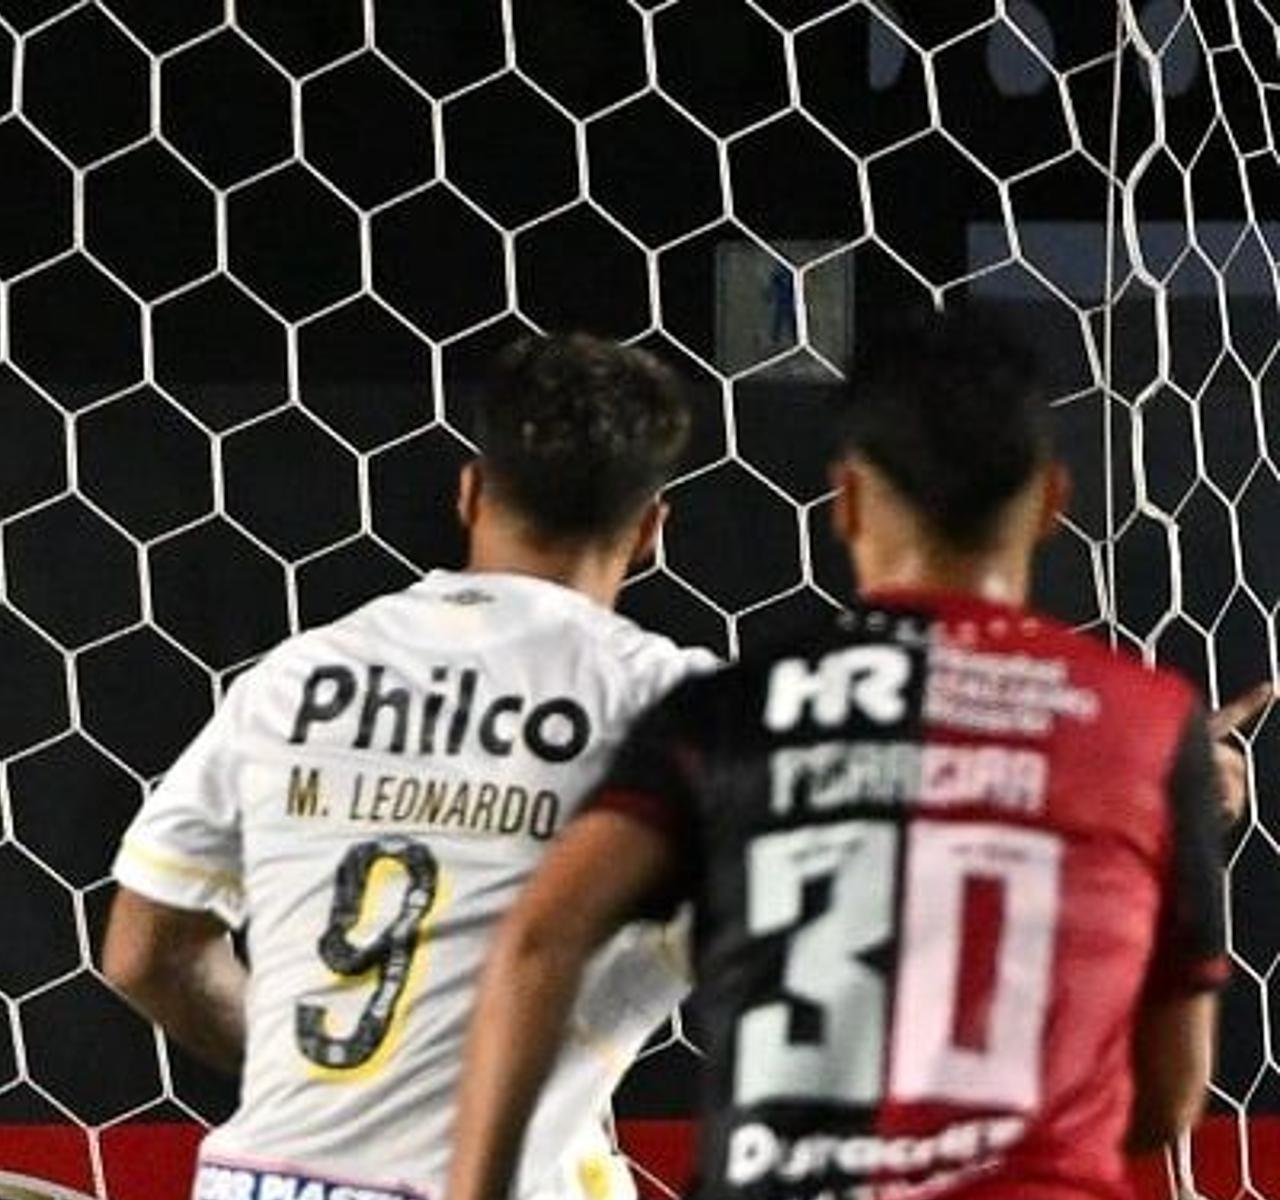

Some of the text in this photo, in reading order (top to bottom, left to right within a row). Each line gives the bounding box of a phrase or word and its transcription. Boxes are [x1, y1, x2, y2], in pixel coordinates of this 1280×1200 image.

[288, 664, 591, 764] Philco
[287, 766, 560, 842] M. LEONARDO
[295, 834, 443, 1074] 9
[732, 819, 1064, 1110] 30
